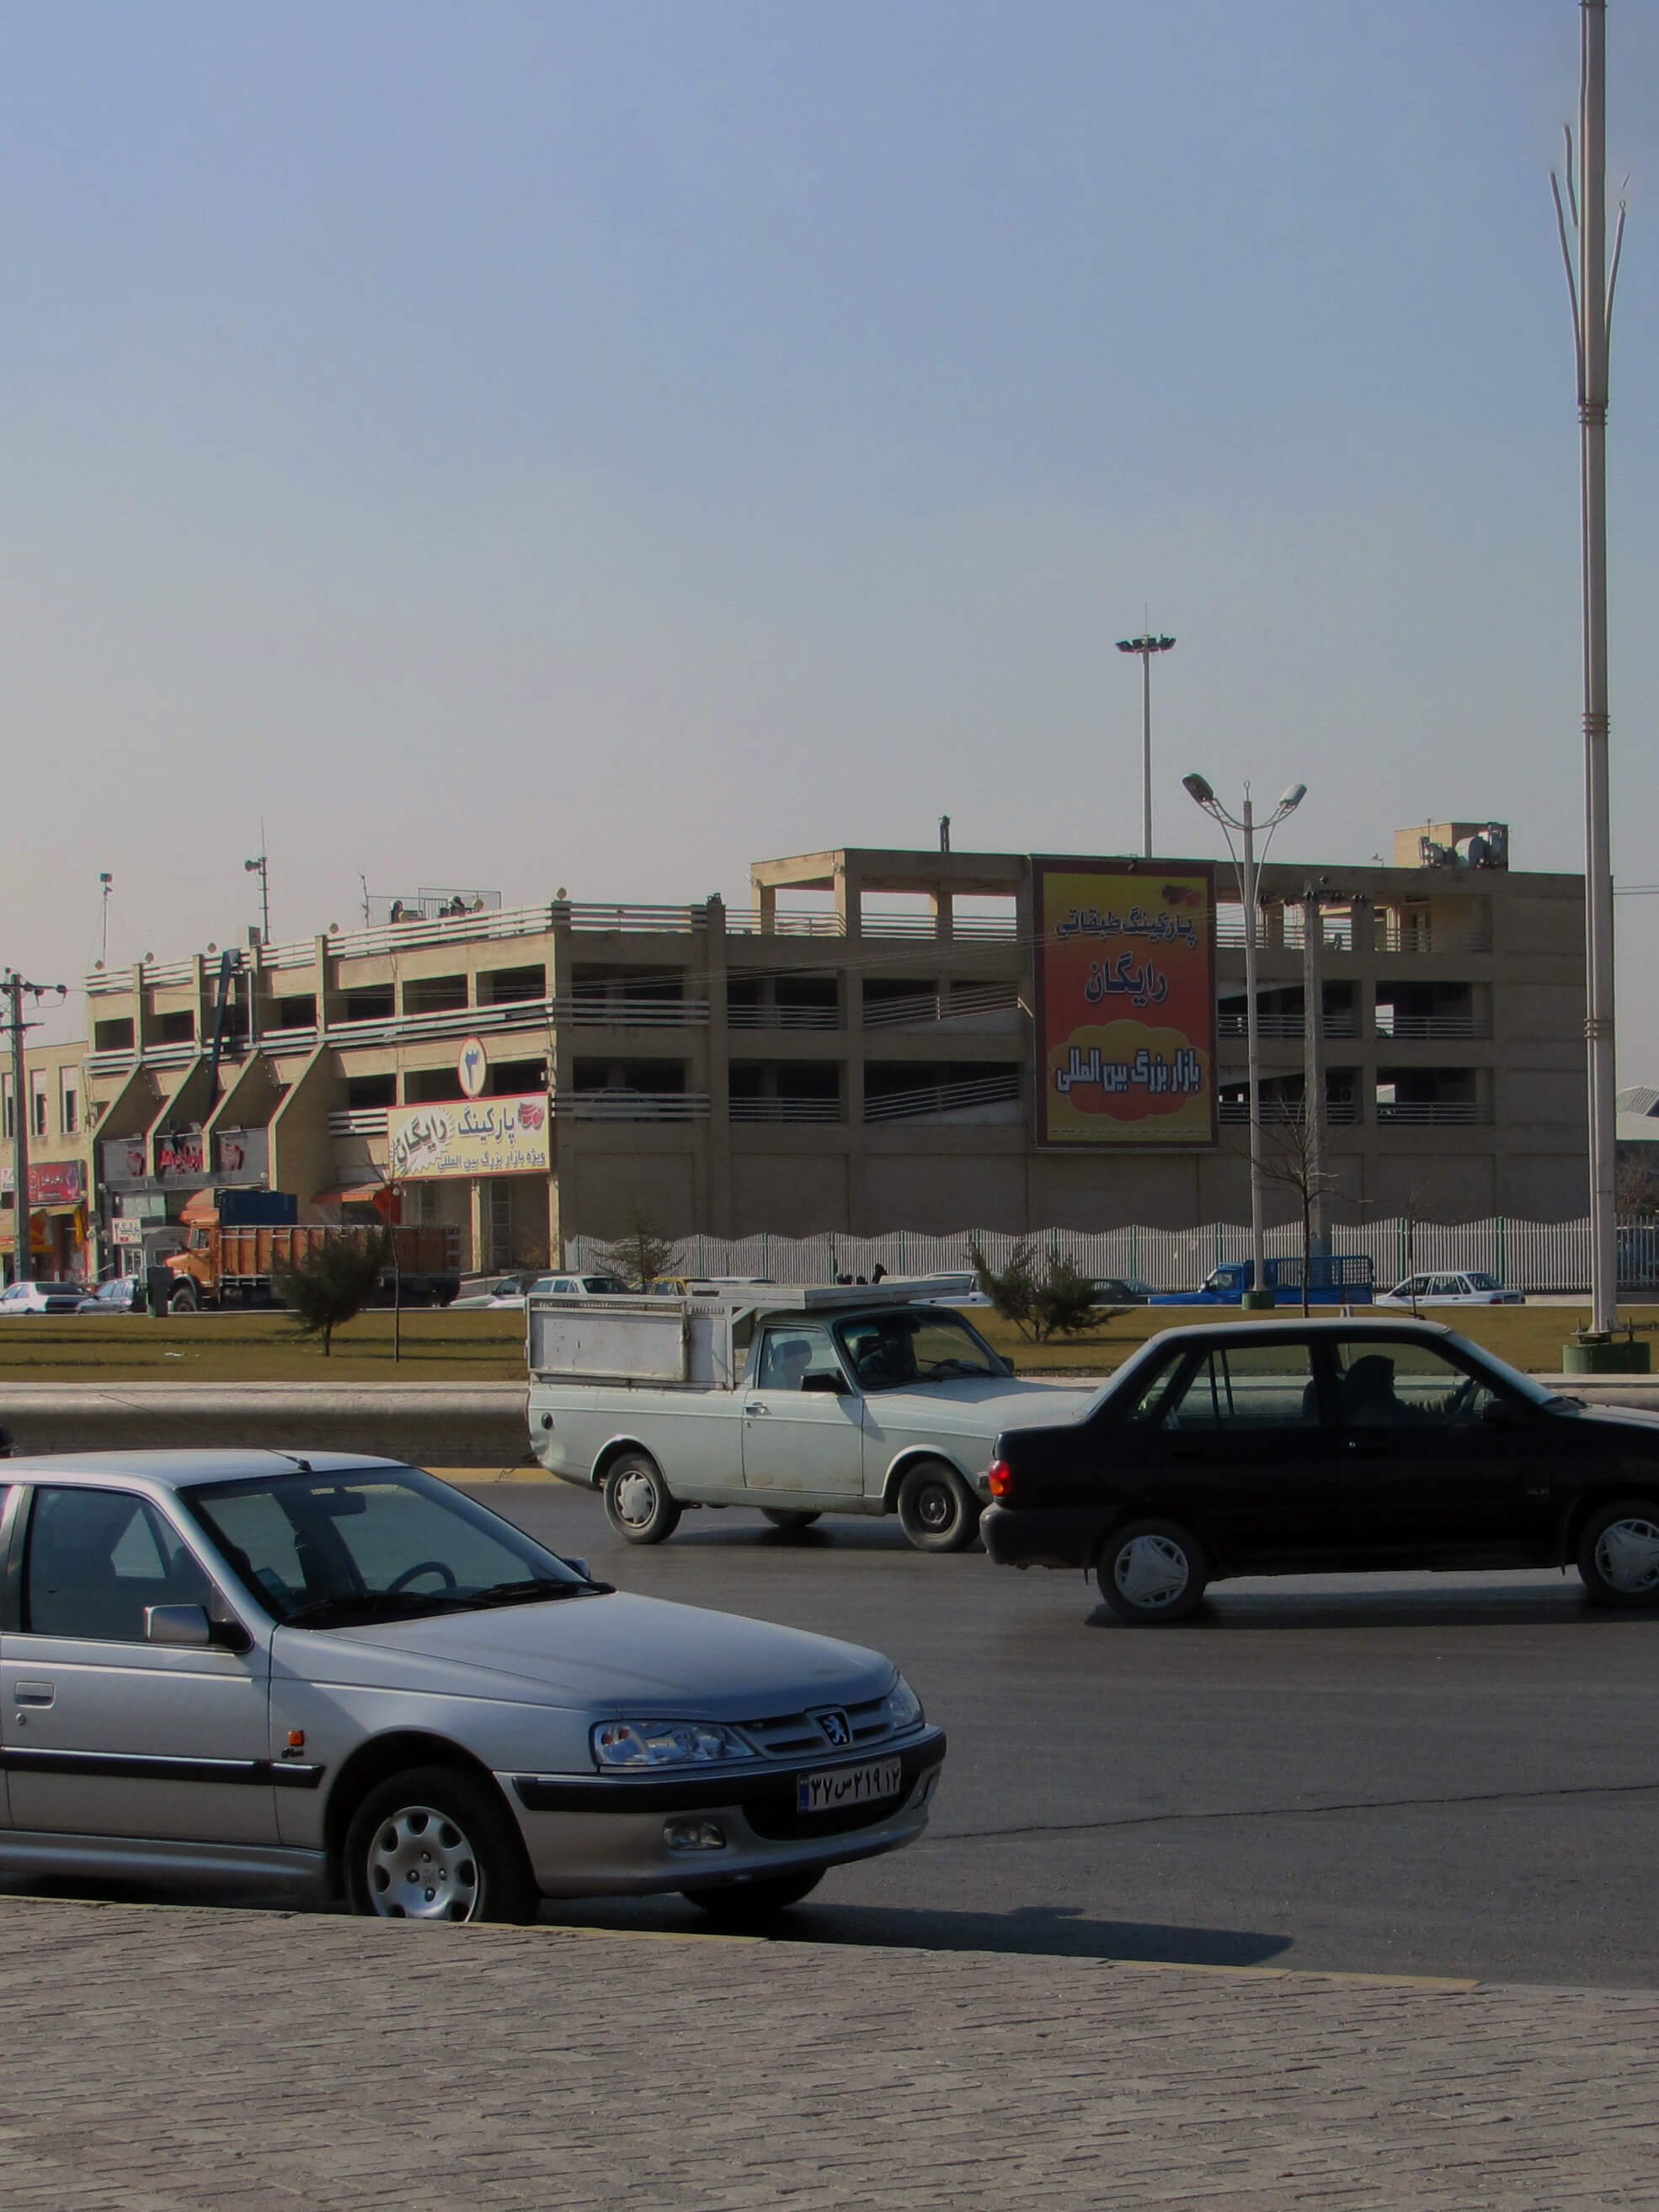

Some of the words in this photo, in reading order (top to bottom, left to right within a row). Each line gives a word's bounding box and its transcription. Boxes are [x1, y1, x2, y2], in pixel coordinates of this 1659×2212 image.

[1055, 909, 1121, 941] طبقاتی
[1123, 908, 1197, 948] پارکینگ
[1084, 951, 1167, 1007] رایگان
[465, 1049, 479, 1089] ۳
[1056, 1046, 1101, 1093] المللی
[1101, 1062, 1128, 1092] بین
[1129, 1048, 1168, 1093] بزرگ
[1171, 1048, 1200, 1093] بازار
[395, 1115, 448, 1164] رایگان
[457, 1106, 515, 1147] پارکینگ
[437, 1154, 462, 1173] المللی
[462, 1158, 479, 1172] بین
[480, 1151, 503, 1170] بزرگ
[505, 1150, 525, 1169] بازار
[525, 1148, 546, 1166] ویژه
